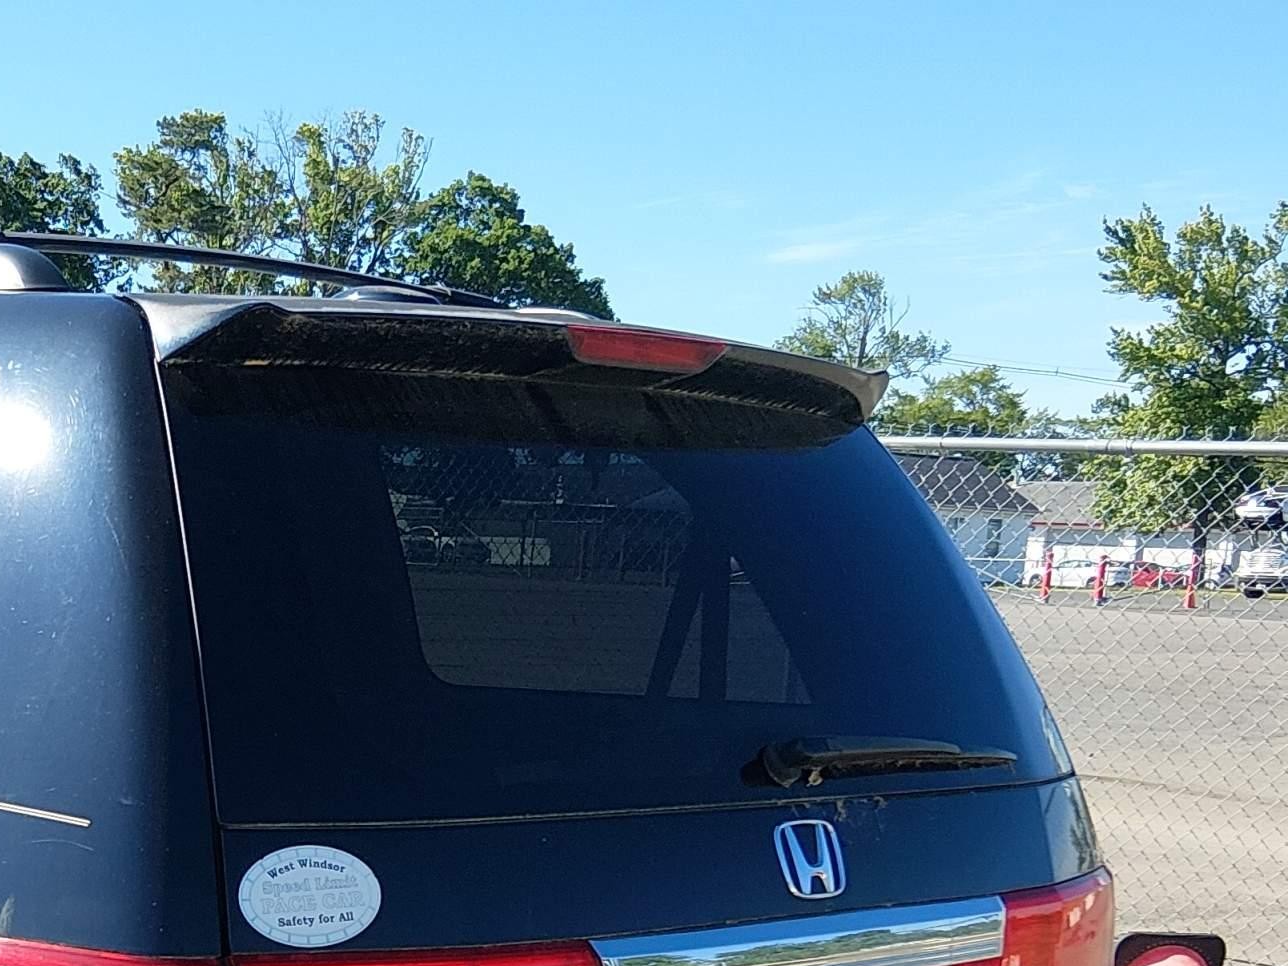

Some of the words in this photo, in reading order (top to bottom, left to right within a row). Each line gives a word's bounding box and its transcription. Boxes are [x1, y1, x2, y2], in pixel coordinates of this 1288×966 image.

[267, 864, 295, 880] West
[297, 859, 346, 873] Windsor
[262, 879, 311, 897] Speed
[315, 875, 359, 890] Limit
[260, 896, 317, 914] PACE
[322, 892, 366, 910] CAR
[278, 916, 314, 928] Safety
[319, 914, 335, 924] for
[339, 912, 354, 921] All
